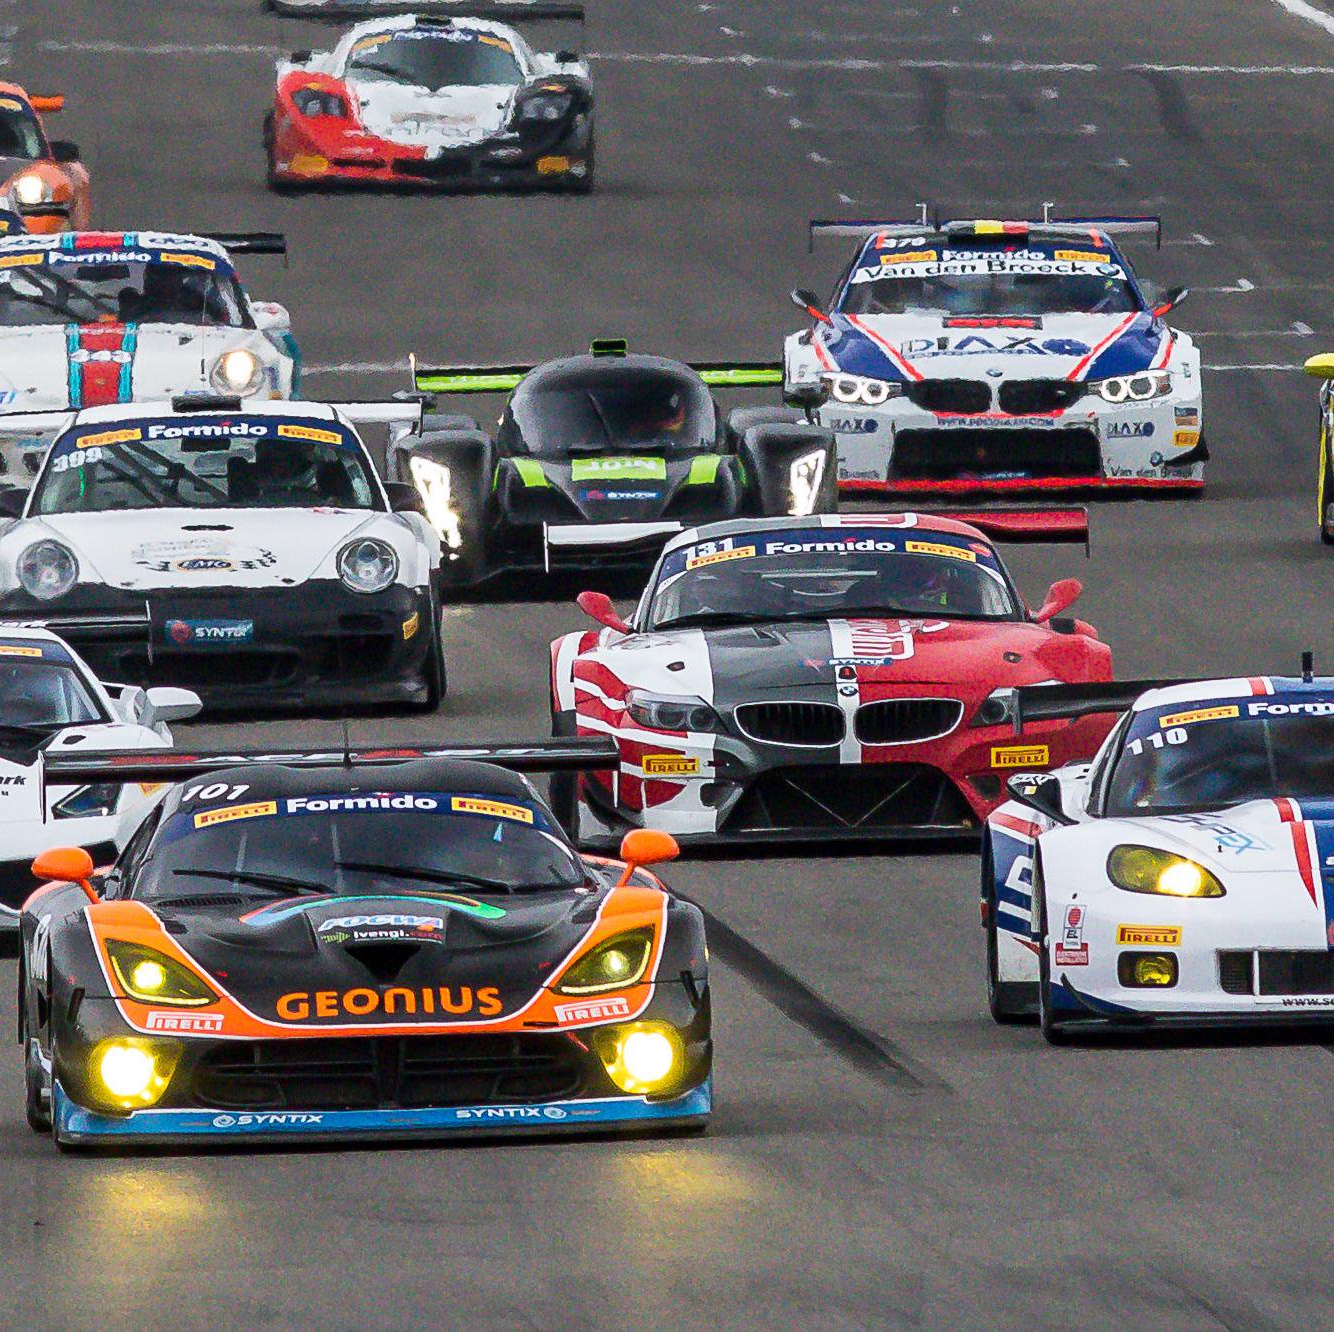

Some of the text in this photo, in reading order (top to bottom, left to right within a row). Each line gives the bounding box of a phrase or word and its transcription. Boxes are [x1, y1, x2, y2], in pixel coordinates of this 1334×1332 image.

[864, 260, 1087, 278] Van den Broeck
[148, 422, 268, 439] Formido
[682, 538, 733, 561] 131
[691, 538, 972, 567] PIRELLI Formido PIRELLI
[1166, 705, 1235, 726] PIRELLI
[1126, 727, 1189, 755] 110
[645, 758, 697, 773] PIRELLI
[995, 748, 1046, 765] PIRELLI
[181, 783, 251, 802] 101
[199, 795, 529, 826] PIRELLI Formido PIRELLI
[1119, 927, 1179, 944] PIRELLI
[275, 986, 504, 1021] GEONIUS
[556, 997, 631, 1023] PIRELLI
[146, 1010, 223, 1031] PIRELLI
[234, 1113, 324, 1125] SYNTIX
[454, 1106, 540, 1118] SYNTIX
